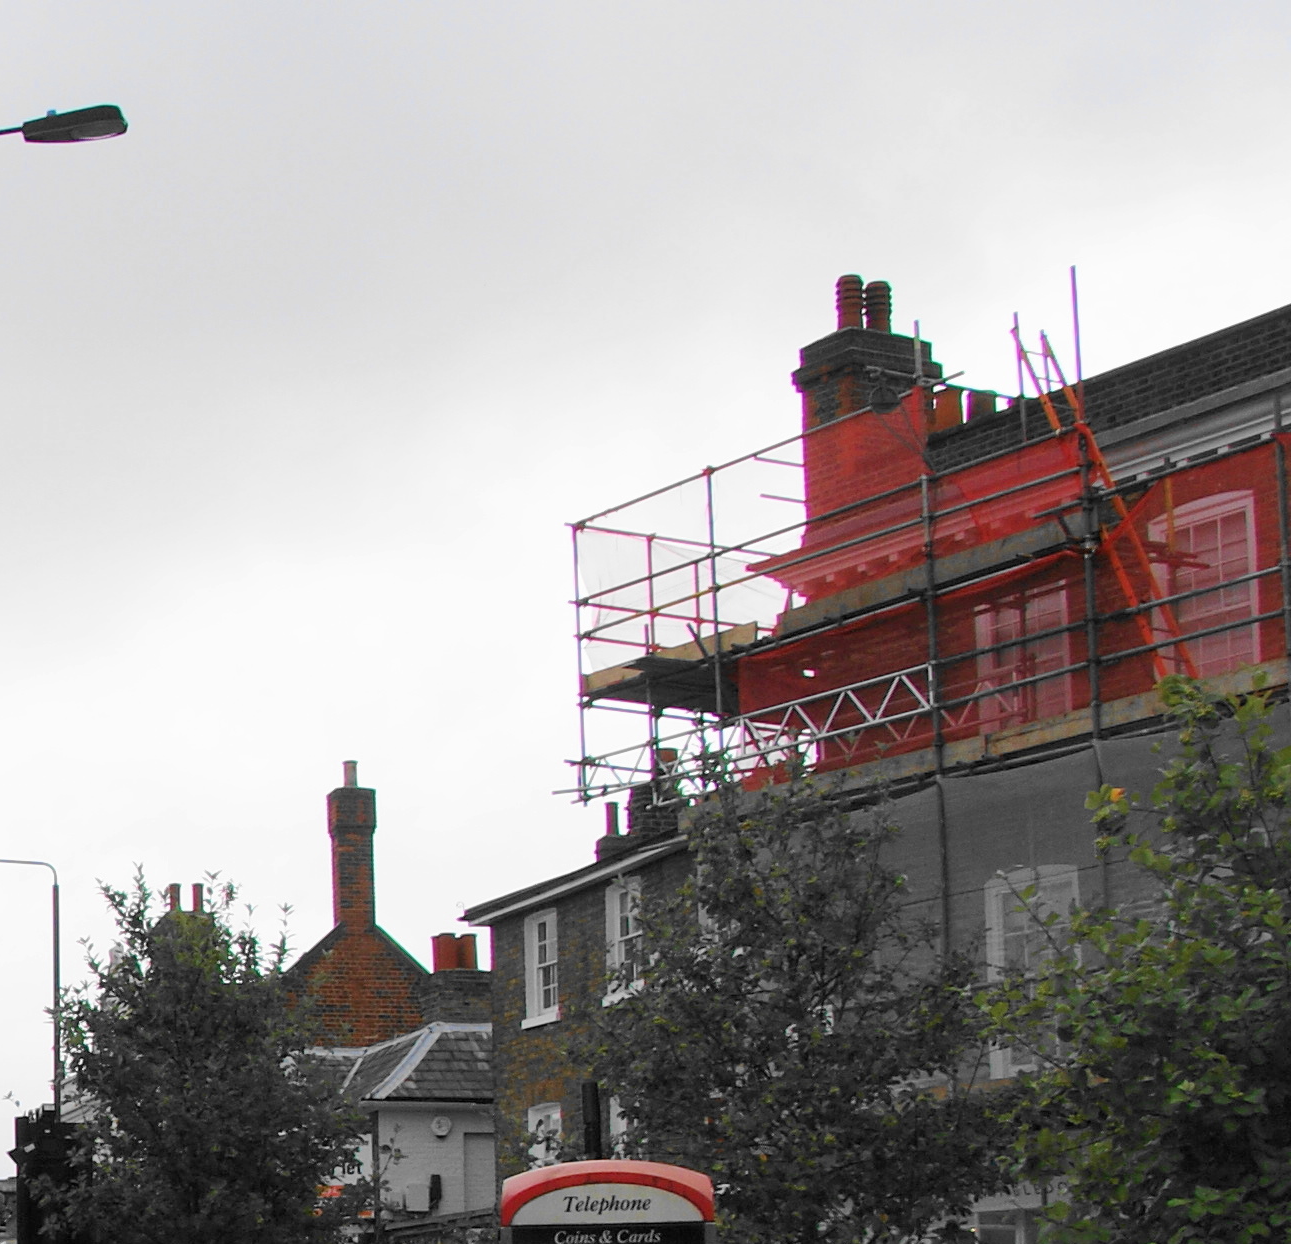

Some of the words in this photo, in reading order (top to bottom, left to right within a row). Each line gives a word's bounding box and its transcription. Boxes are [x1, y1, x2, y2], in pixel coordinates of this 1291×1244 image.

[563, 1195, 651, 1215] Telephone
[554, 1230, 597, 1244] Coins
[599, 1229, 613, 1244] &
[616, 1229, 662, 1244] Cards
